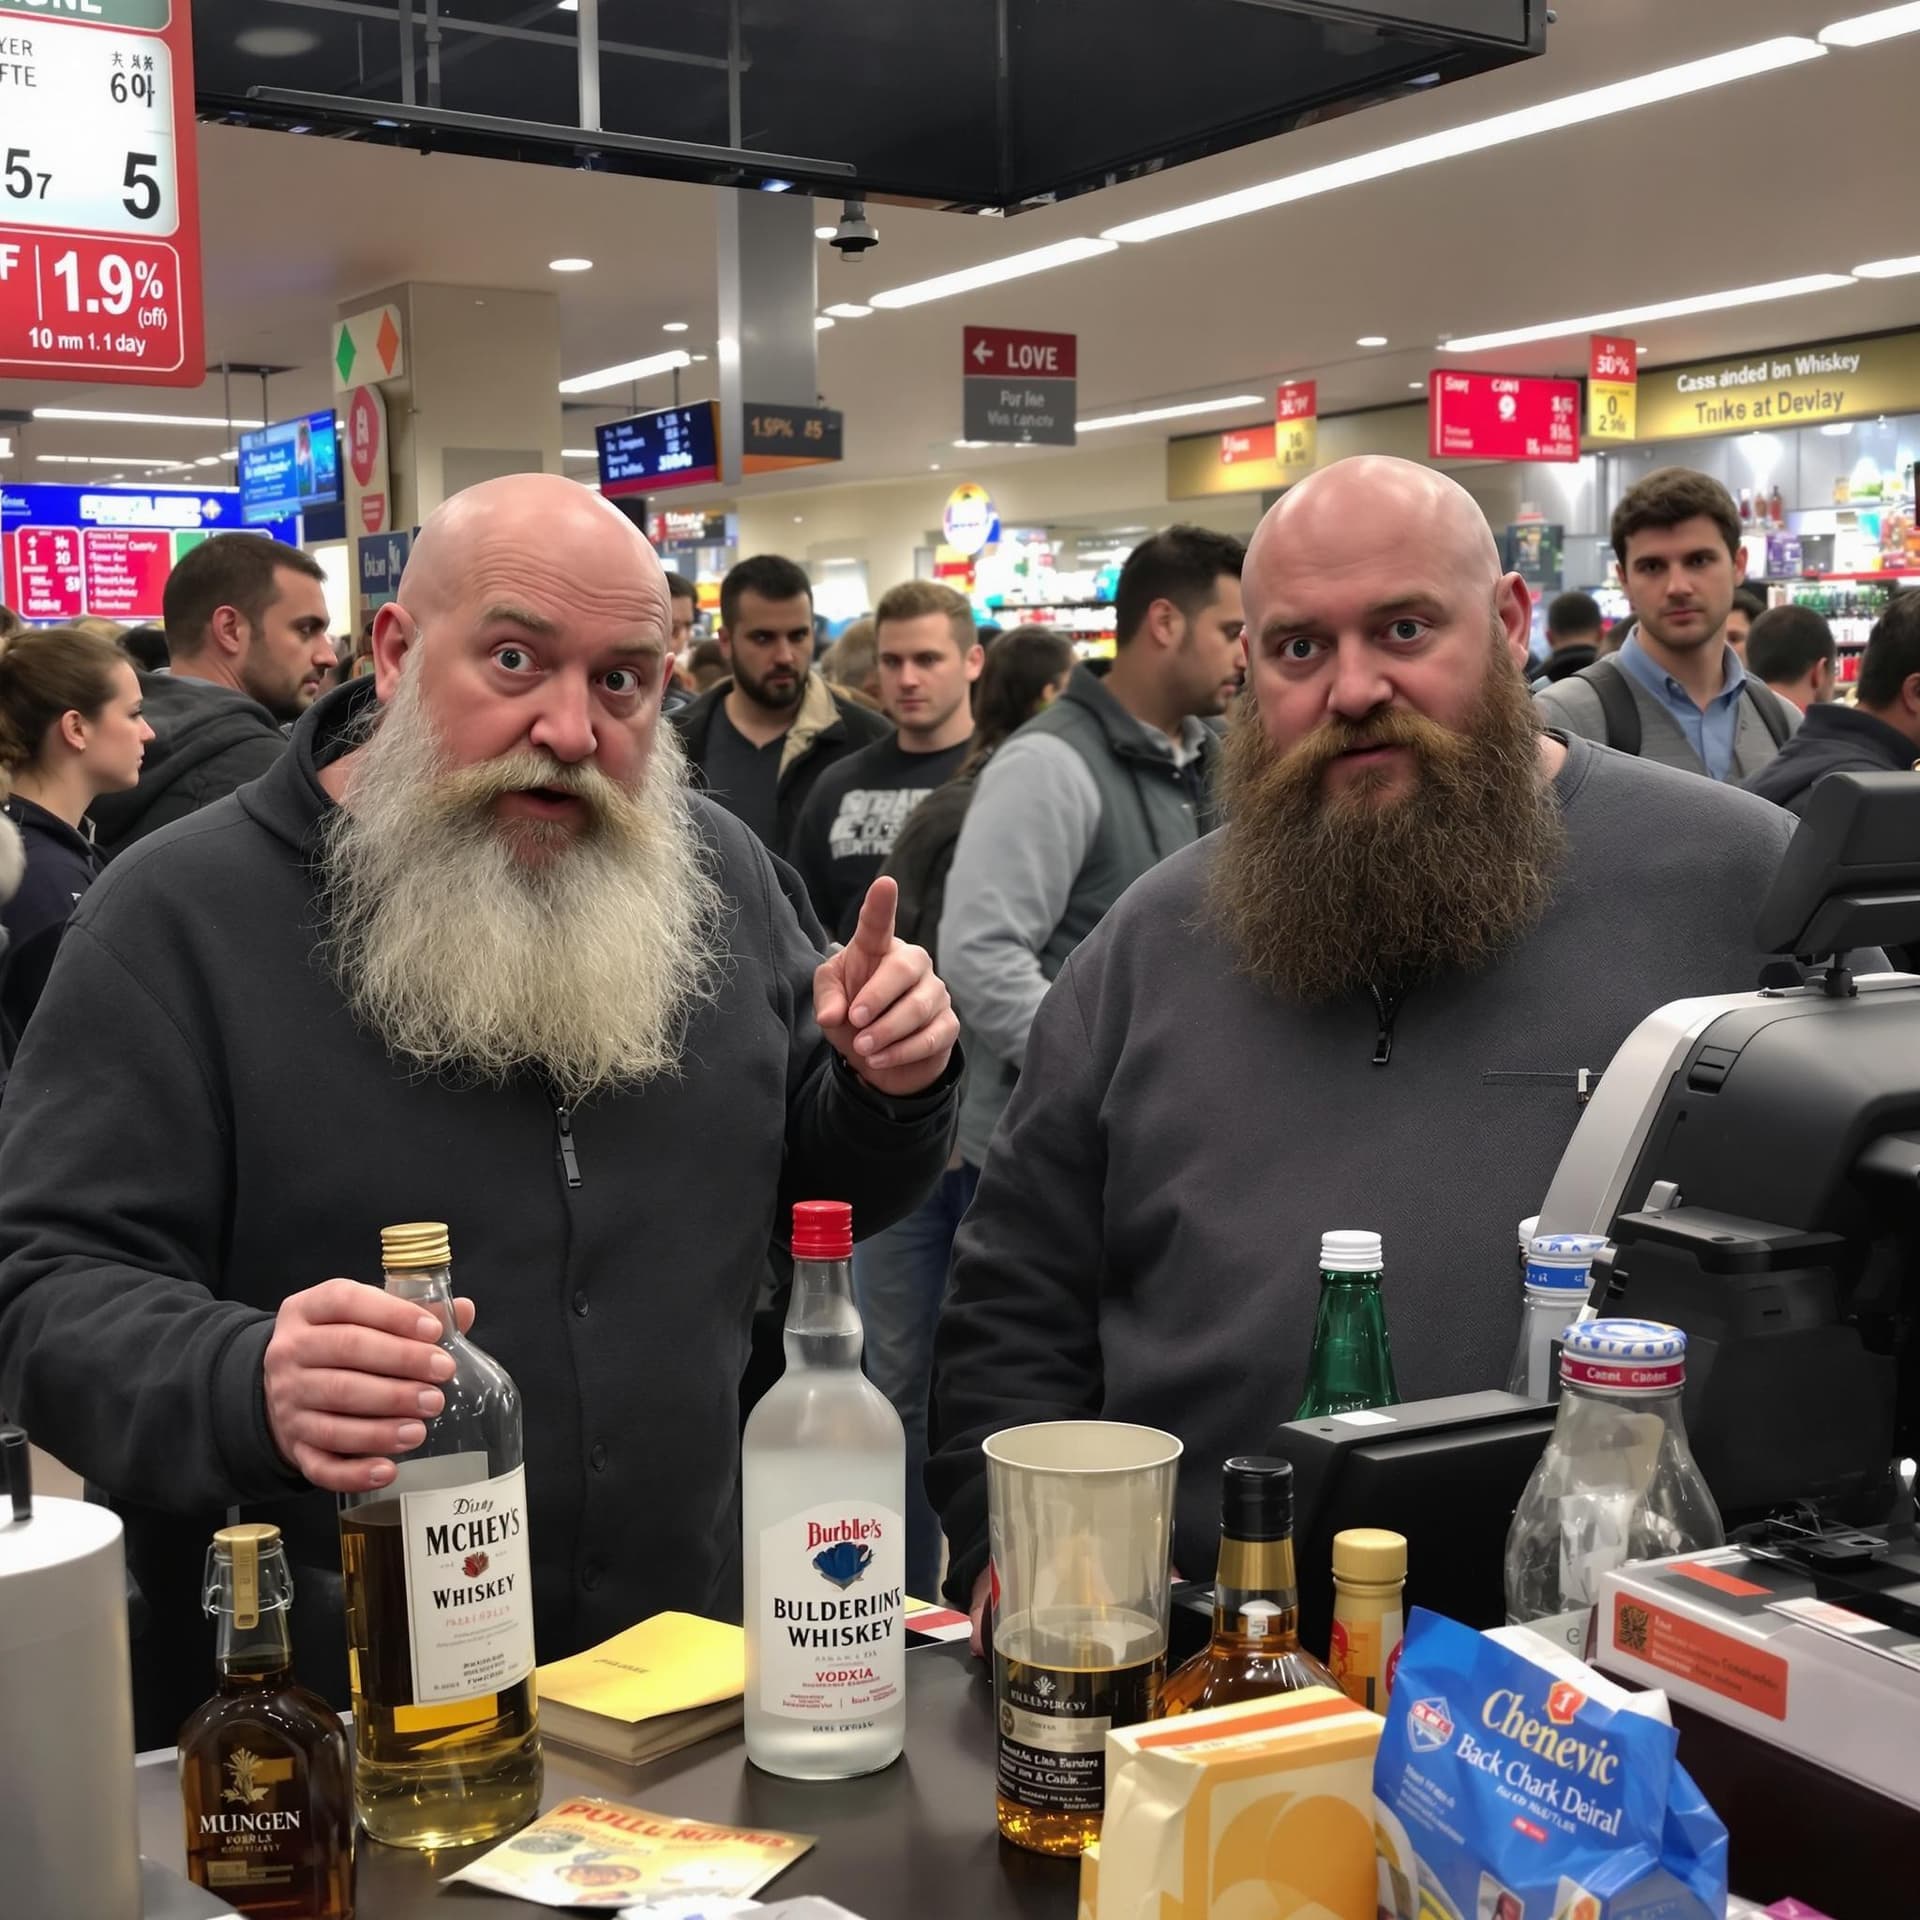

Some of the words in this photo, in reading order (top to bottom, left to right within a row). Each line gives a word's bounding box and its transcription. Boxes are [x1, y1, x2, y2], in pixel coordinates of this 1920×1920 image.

[121, 151, 161, 220] 5
[28, 327, 54, 350] 10
[114, 333, 147, 357] day
[1006, 343, 1060, 371] LOVE
[1794, 351, 1861, 375] Whiskey
[1753, 397, 1772, 418] at
[425, 1507, 520, 1557] MCHEY'S
[787, 1616, 894, 1648] WHISKEY
[1455, 1733, 1503, 1777] Back
[1505, 1760, 1560, 1808] Chark
[1561, 1785, 1623, 1837] Deiral
[199, 1810, 301, 1834] MUNGEN
